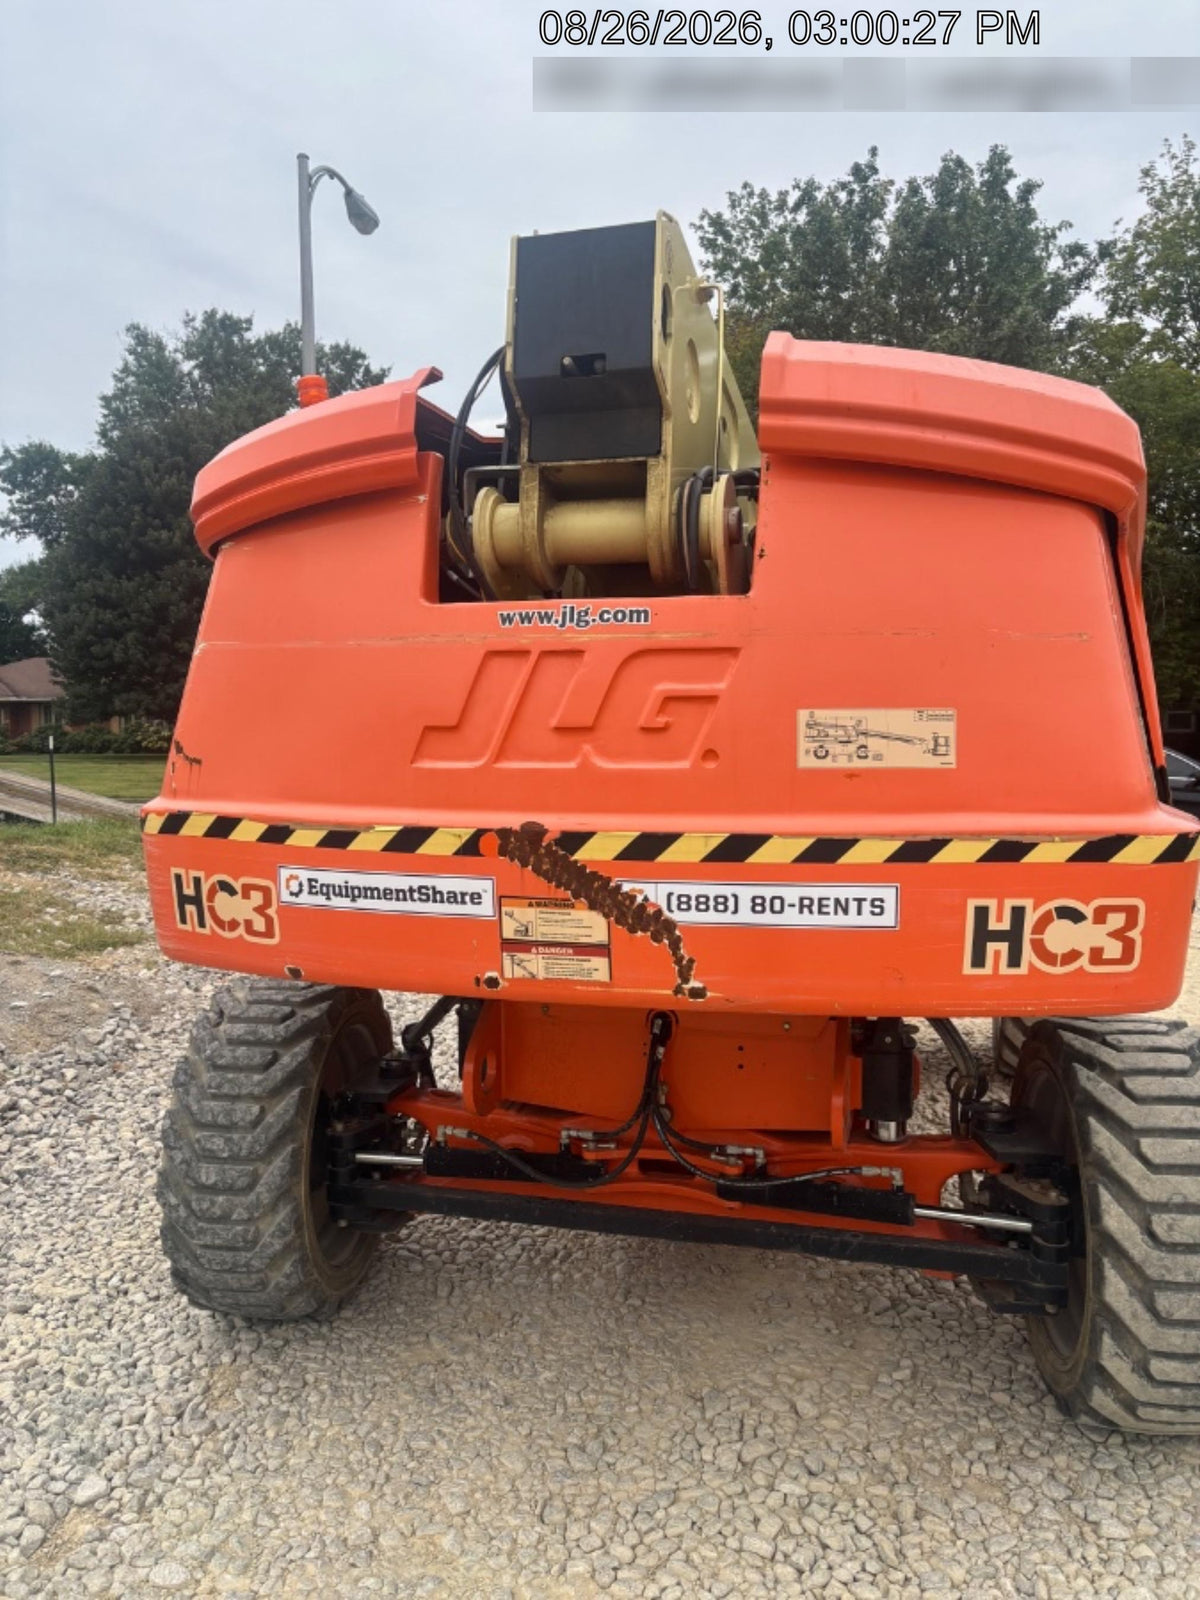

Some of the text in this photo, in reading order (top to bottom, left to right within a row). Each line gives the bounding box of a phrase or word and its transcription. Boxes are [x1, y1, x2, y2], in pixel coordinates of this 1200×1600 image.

[499, 605, 650, 628] www.jlg.com
[172, 870, 278, 941] HC3
[665, 891, 886, 917] (888) 80-RENTS
[968, 903, 1141, 970] HC3
[538, 946, 574, 955] DANGER
